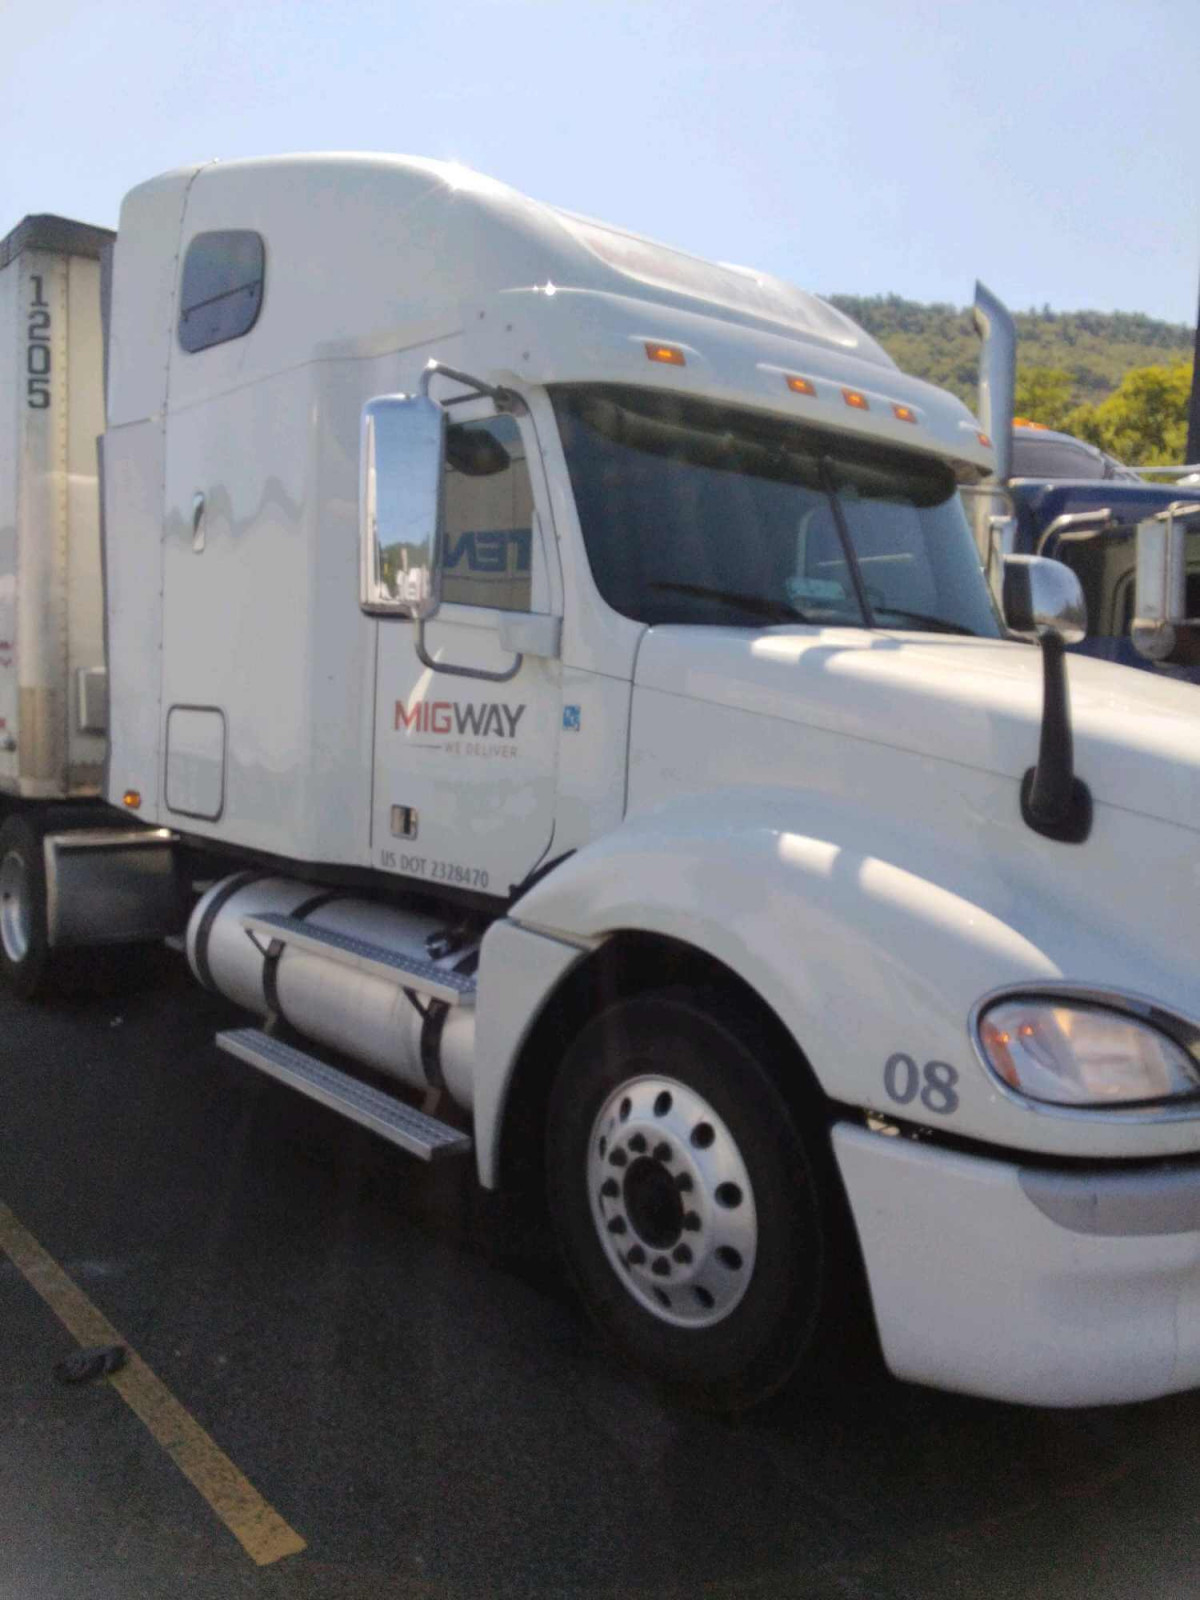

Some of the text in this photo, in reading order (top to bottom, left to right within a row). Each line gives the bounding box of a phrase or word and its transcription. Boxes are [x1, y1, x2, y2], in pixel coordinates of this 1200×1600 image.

[28, 275, 51, 410] 1205
[394, 700, 526, 738] MIGWAY
[465, 742, 518, 759] DELIVER
[381, 848, 490, 888] US DOT 2328470
[883, 1051, 960, 1115] 08
